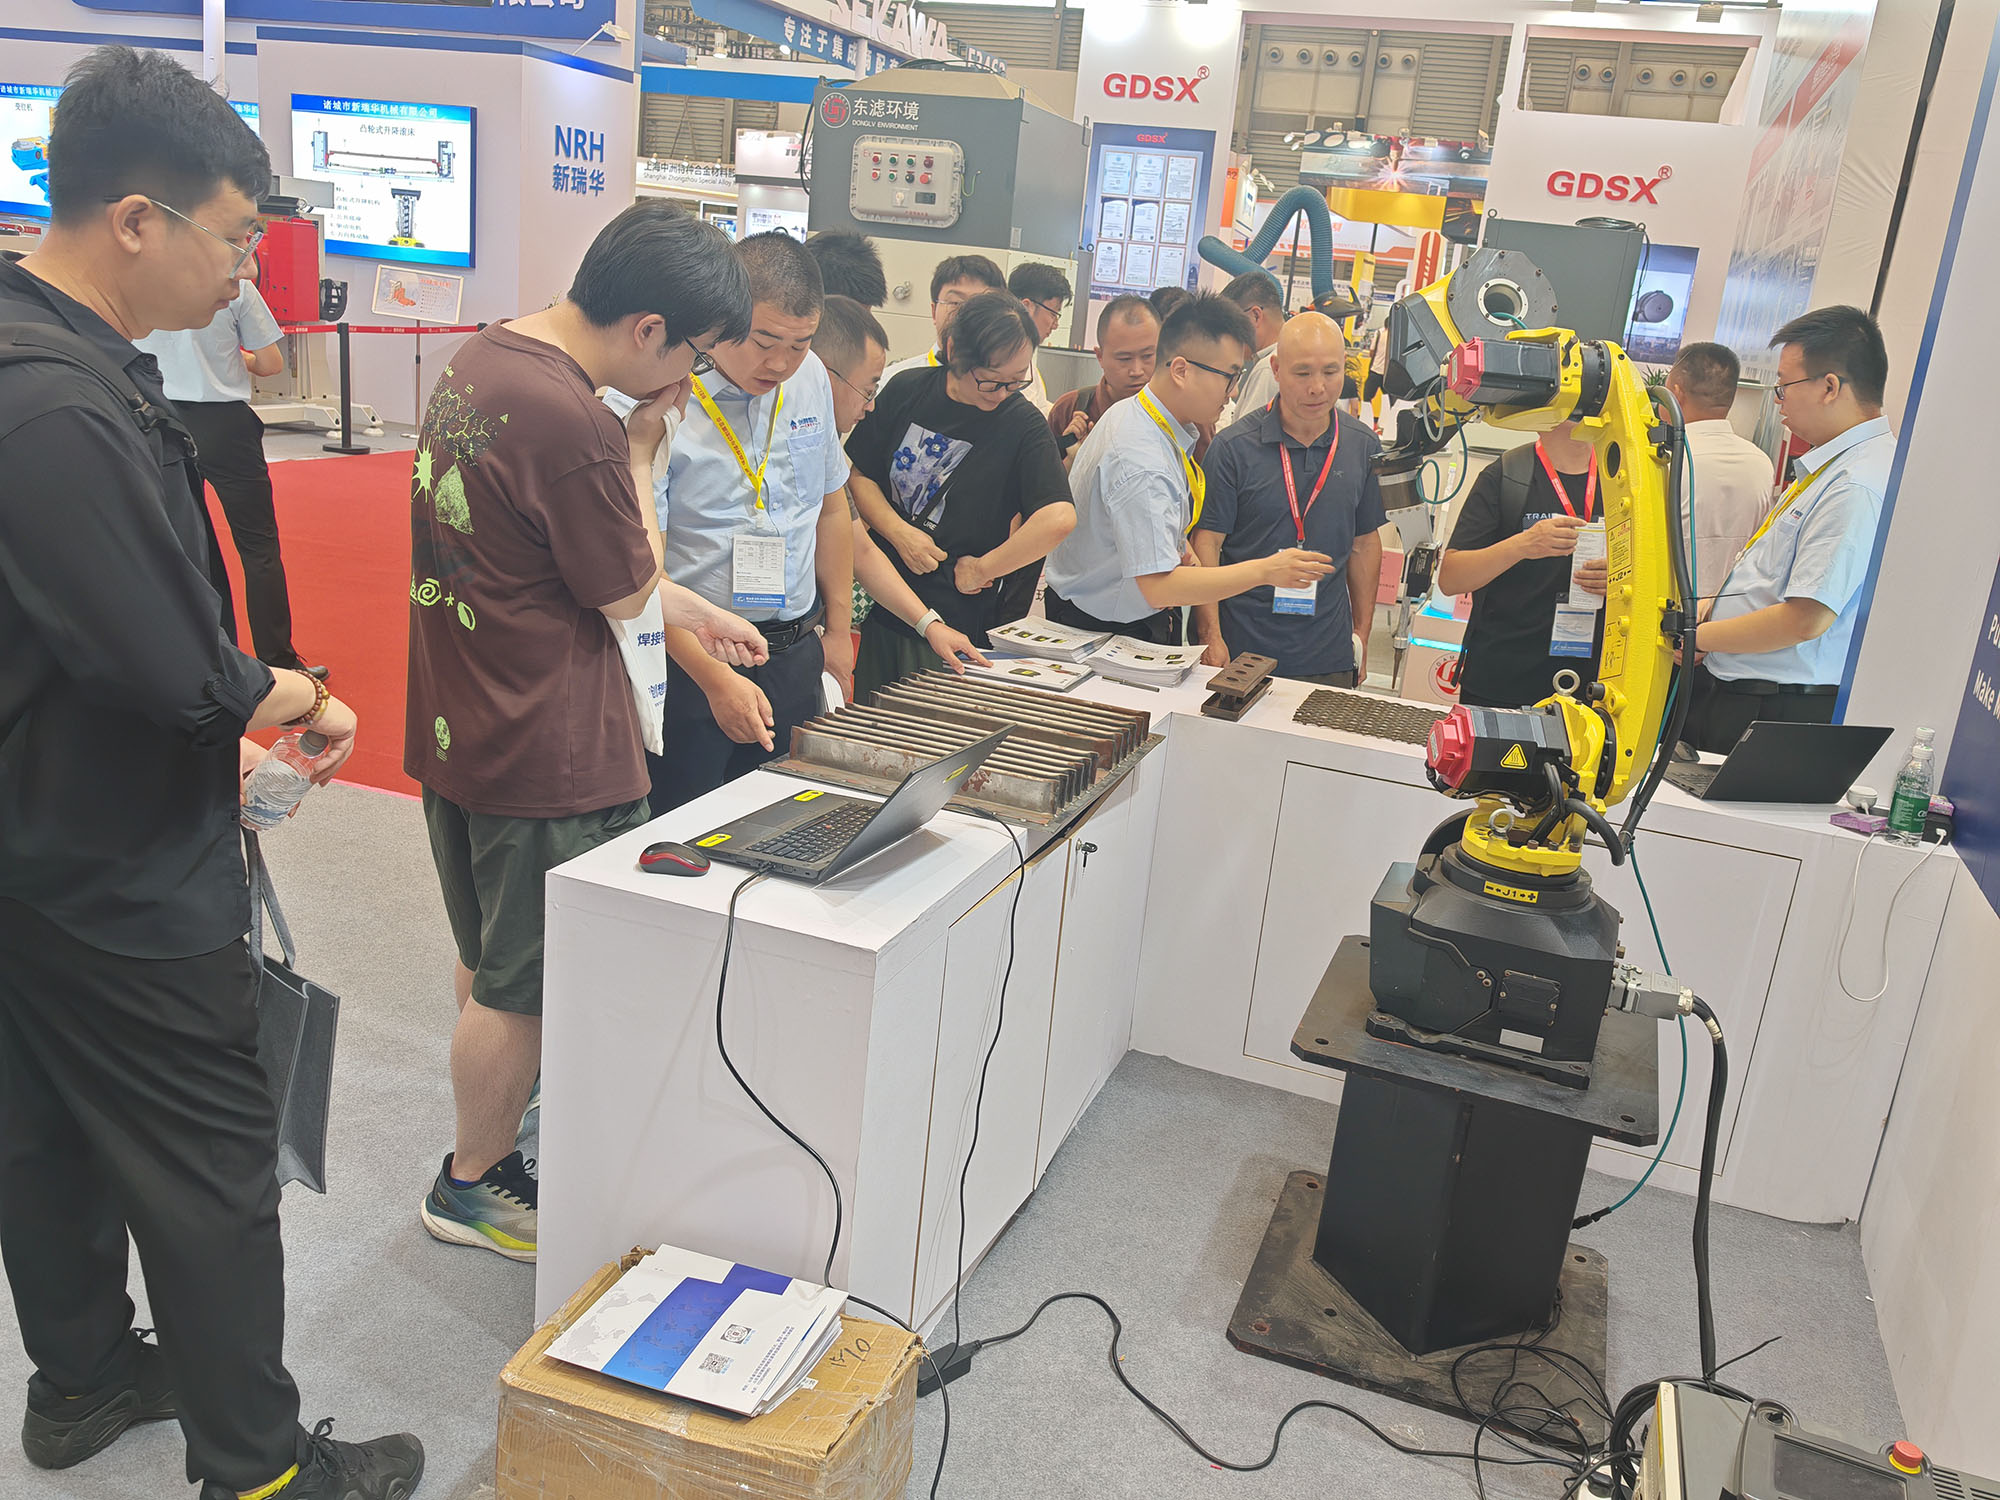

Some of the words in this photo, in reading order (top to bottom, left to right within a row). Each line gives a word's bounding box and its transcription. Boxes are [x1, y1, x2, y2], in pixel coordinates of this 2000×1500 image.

[1103, 73, 1200, 103] GDSX
[323, 99, 438, 118] 诸城市新瑞华机械有限公司
[853, 97, 920, 121] 东滤环境
[877, 121, 918, 131] ENVIRONMENT
[1136, 133, 1166, 144] GDSX
[554, 124, 604, 163] NRH
[552, 163, 605, 197] 新瑞华
[643, 173, 667, 181] Shanghai
[1547, 170, 1660, 205] GDSX
[1973, 669, 1996, 712] Make
